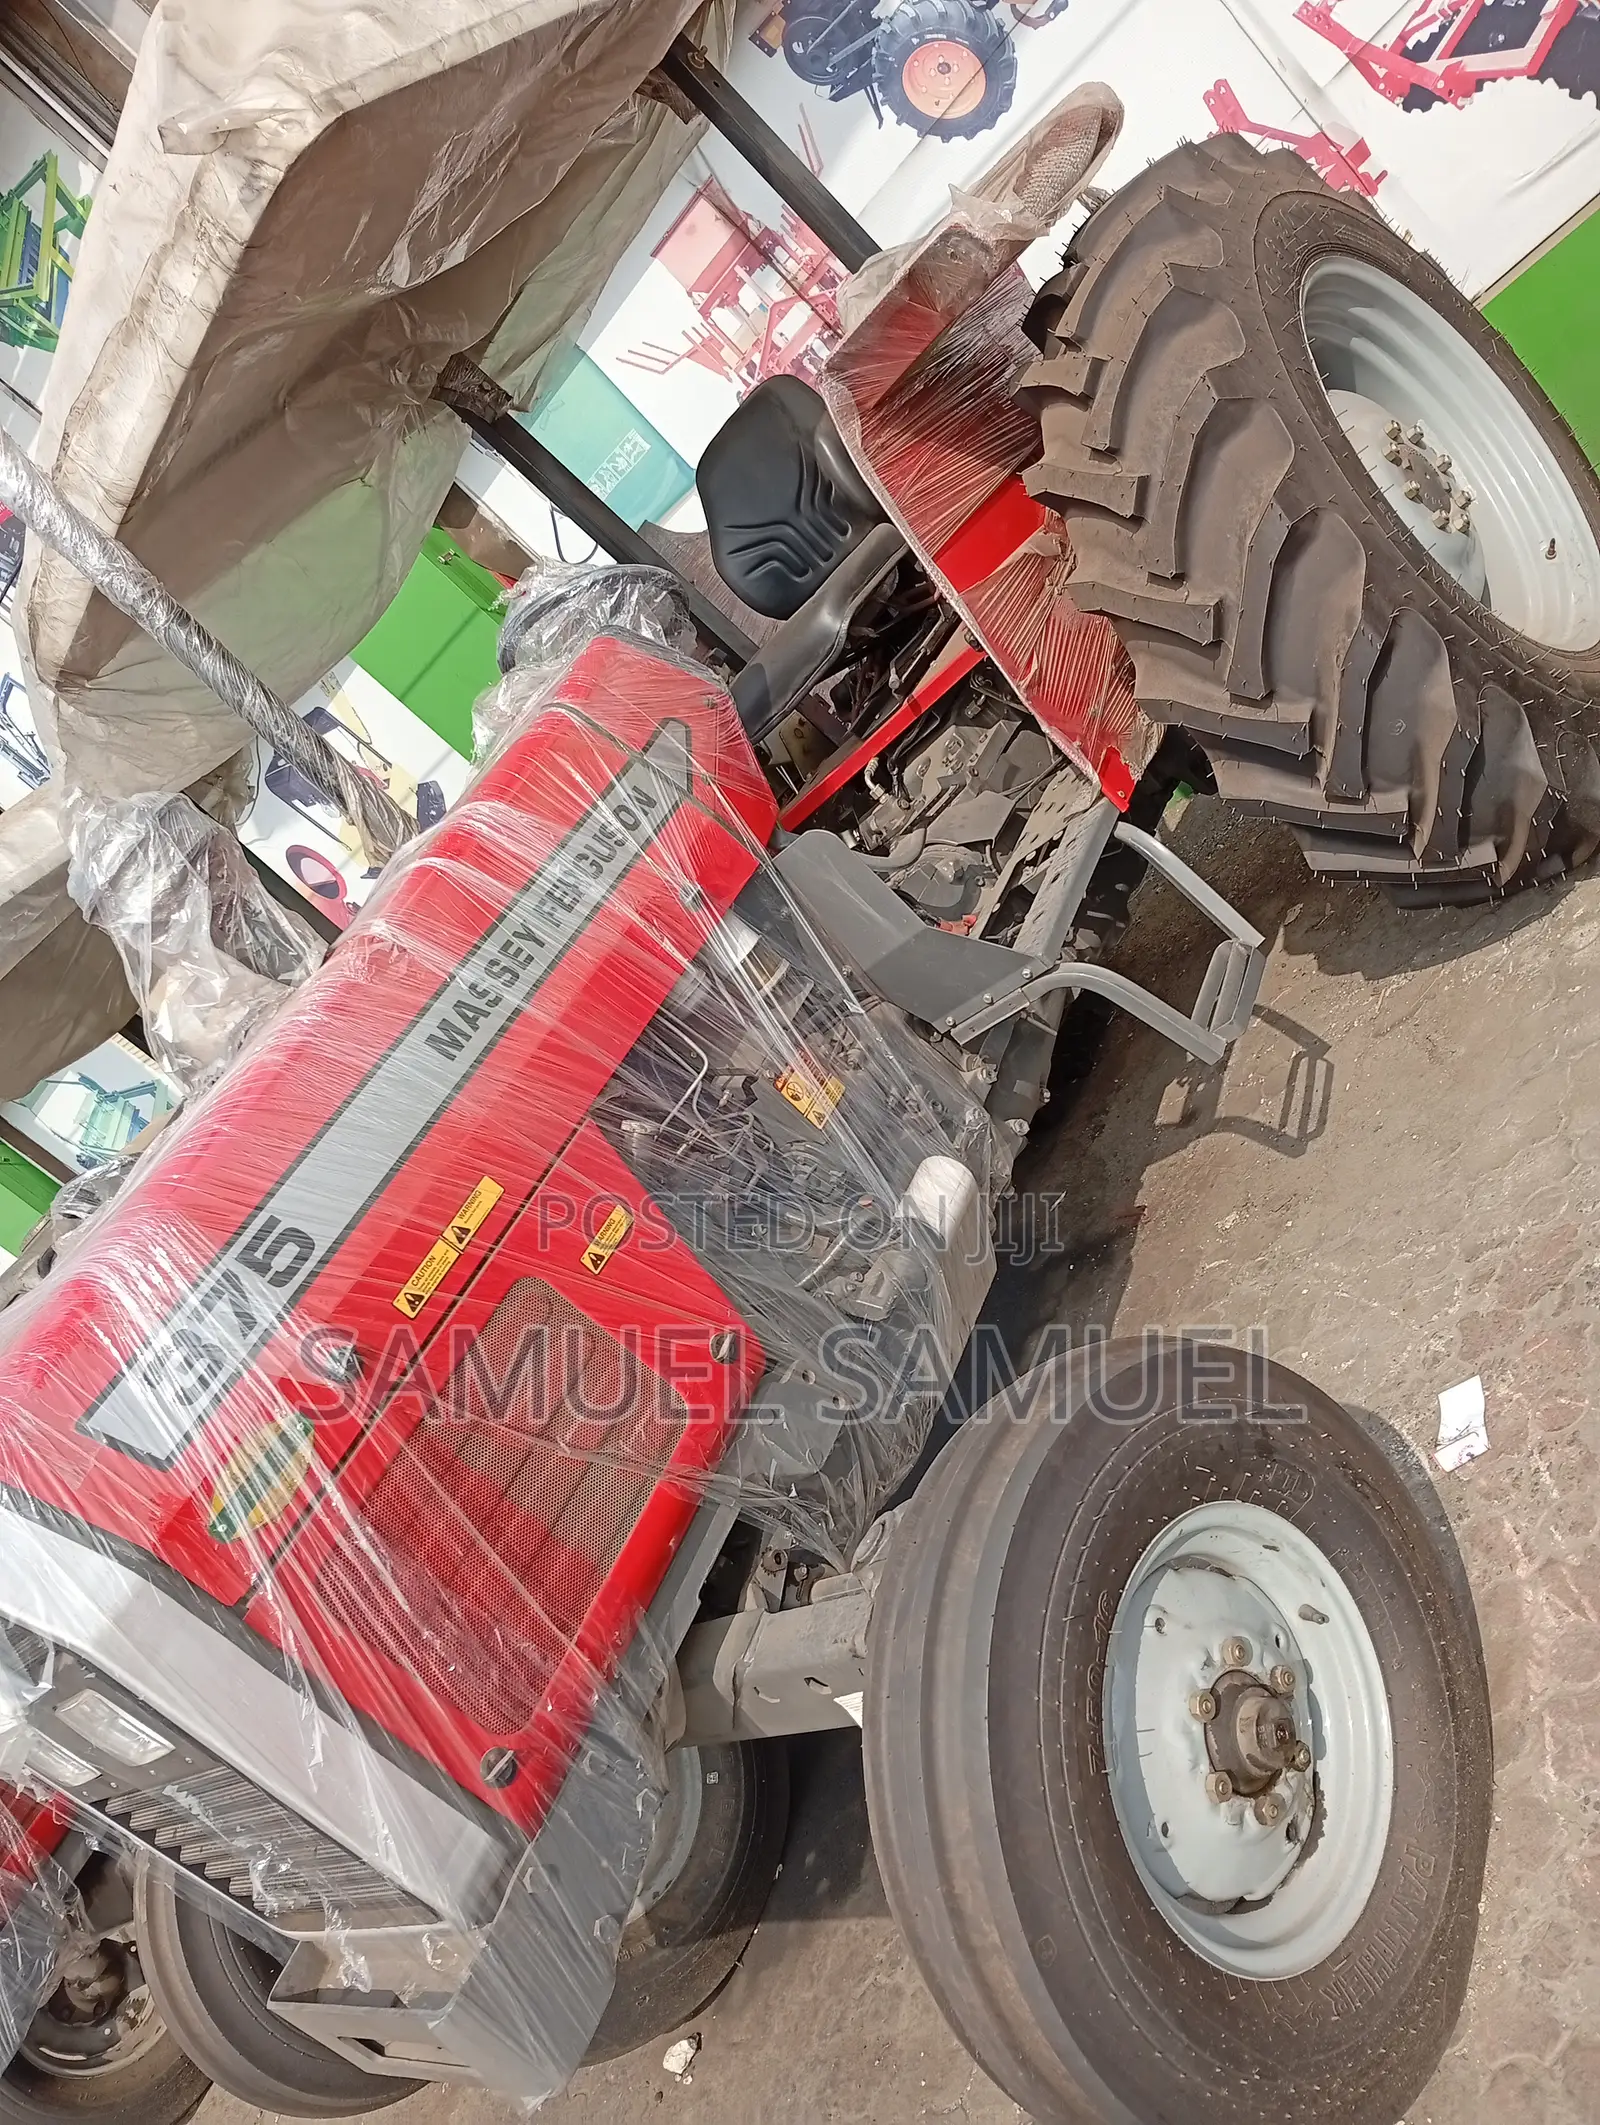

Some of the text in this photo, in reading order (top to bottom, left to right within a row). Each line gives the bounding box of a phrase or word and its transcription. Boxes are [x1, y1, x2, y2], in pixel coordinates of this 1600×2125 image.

[423, 785, 658, 1061] MASSEY FERGUSON
[457, 1189, 482, 1220] WARNING
[593, 1218, 616, 1247] WARNING
[411, 1255, 437, 1287] CAUTION
[1319, 1843, 1437, 2017] PANTHER
